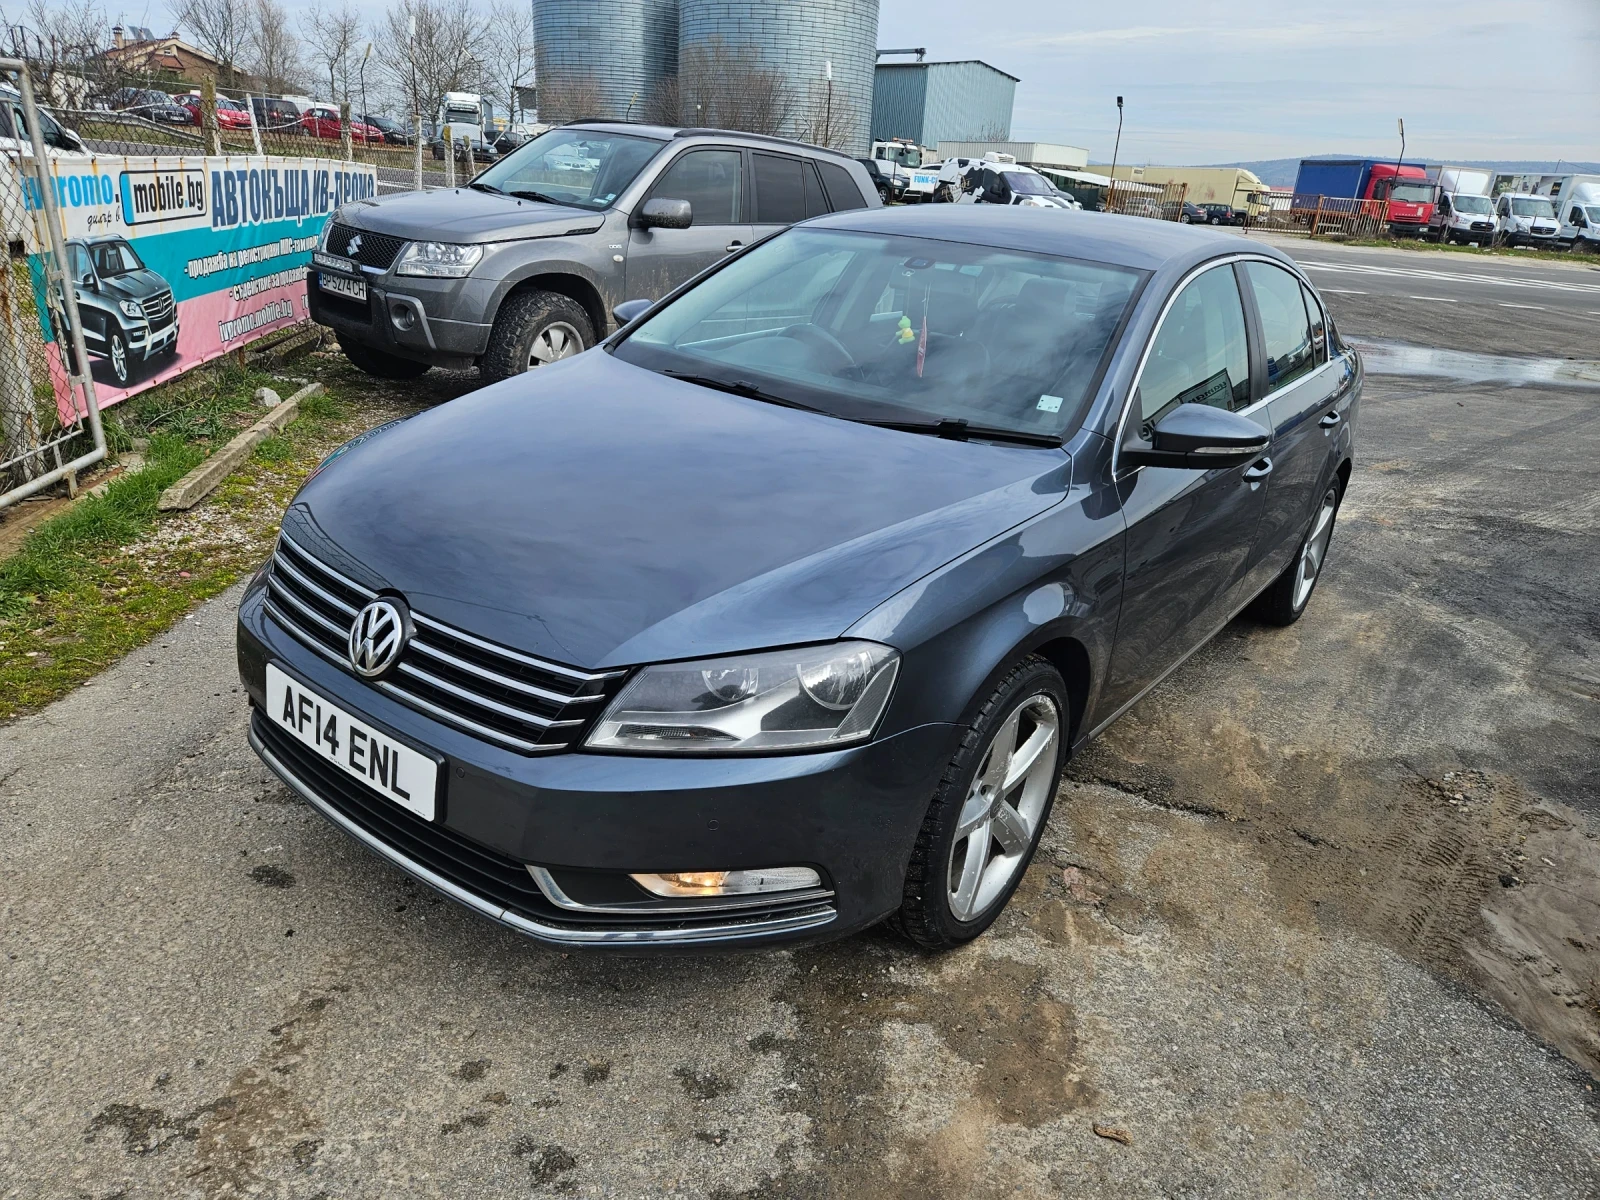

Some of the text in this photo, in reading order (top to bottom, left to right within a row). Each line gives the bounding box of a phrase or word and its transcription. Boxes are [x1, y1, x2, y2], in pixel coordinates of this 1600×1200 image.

[133, 175, 204, 213] mobile.bg
[211, 169, 310, 228] АВТОКЪЩА
[218, 298, 294, 343] ivpromo.mobile.bg
[282, 685, 411, 801] AF14 ENL
